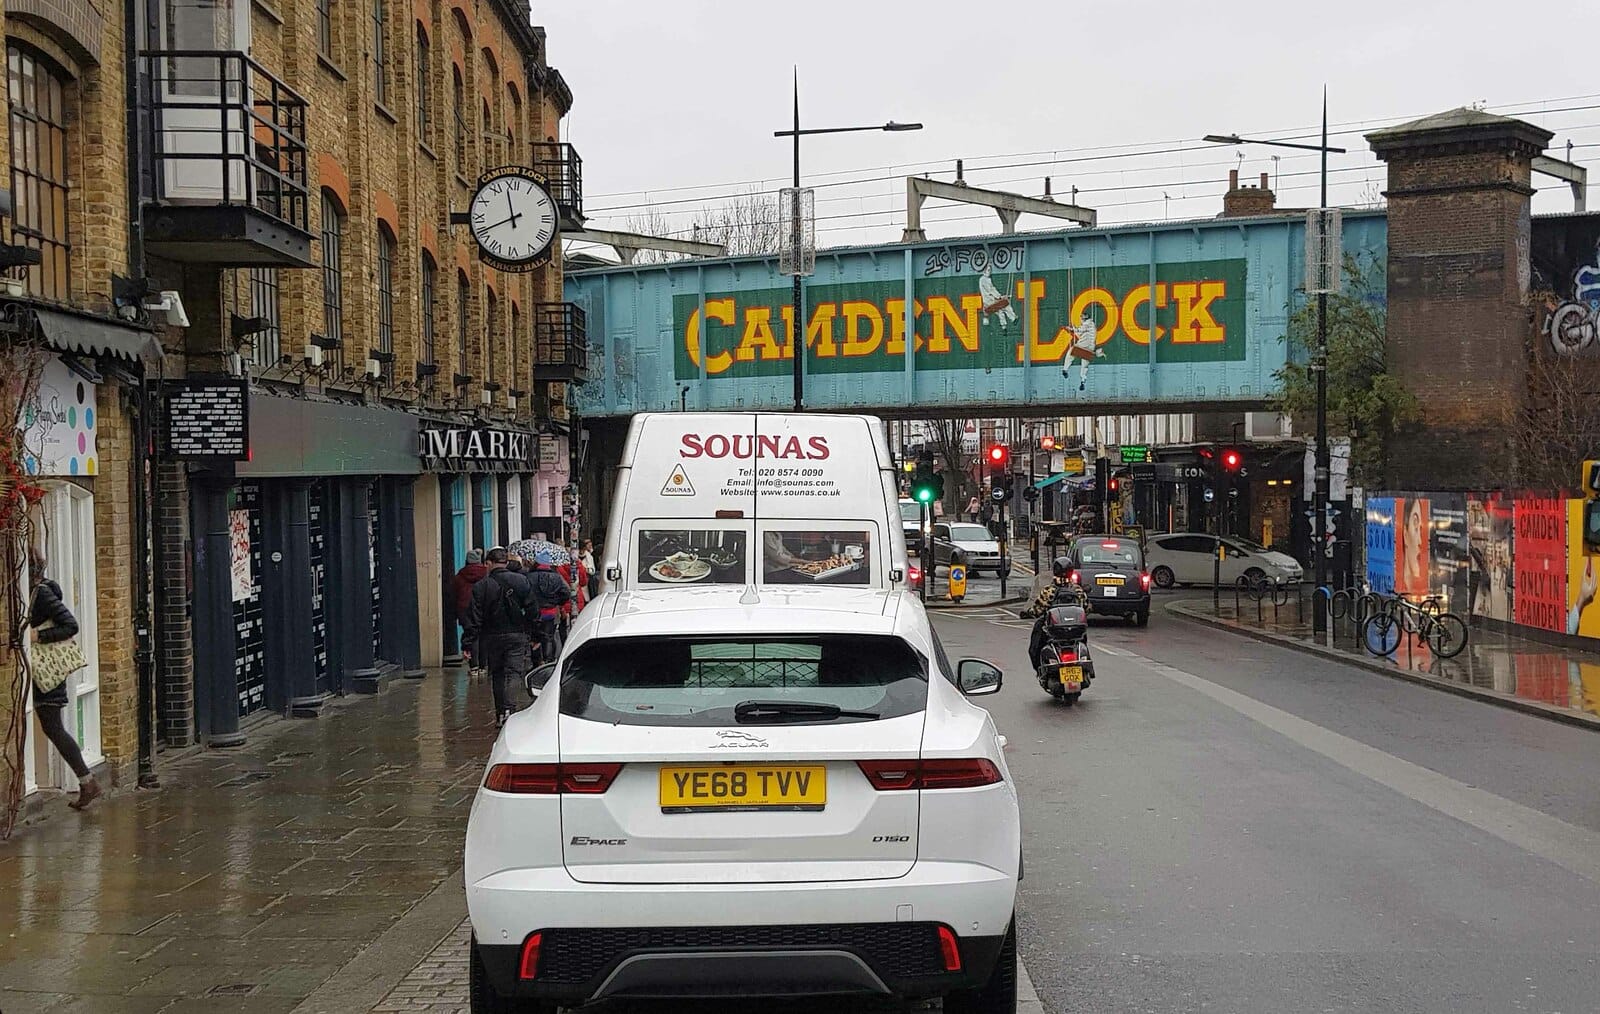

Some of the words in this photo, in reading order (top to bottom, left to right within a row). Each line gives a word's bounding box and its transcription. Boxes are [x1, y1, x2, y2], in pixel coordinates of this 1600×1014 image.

[481, 167, 520, 183] CAMDEN
[521, 167, 547, 184] LOCK
[523, 257, 548, 271] HALL
[685, 295, 982, 374] CAMDEN
[1016, 278, 1226, 363] LOCK
[425, 429, 528, 461] MARKE
[679, 433, 830, 460] SOUNAS
[757, 479, 834, 488] info@sounas.com
[758, 468, 775, 477] 020
[777, 468, 799, 477] 8574
[801, 468, 824, 477] 0090
[760, 488, 841, 497] www.sounas.co.uk
[1369, 528, 1392, 551] SOON
[1520, 514, 1559, 541] CAMDEN
[1521, 570, 1545, 598] ONLY
[1549, 573, 1559, 600] IN
[1520, 598, 1560, 630] CAMDEN
[673, 771, 748, 798] YE68
[757, 771, 811, 797] TVV
